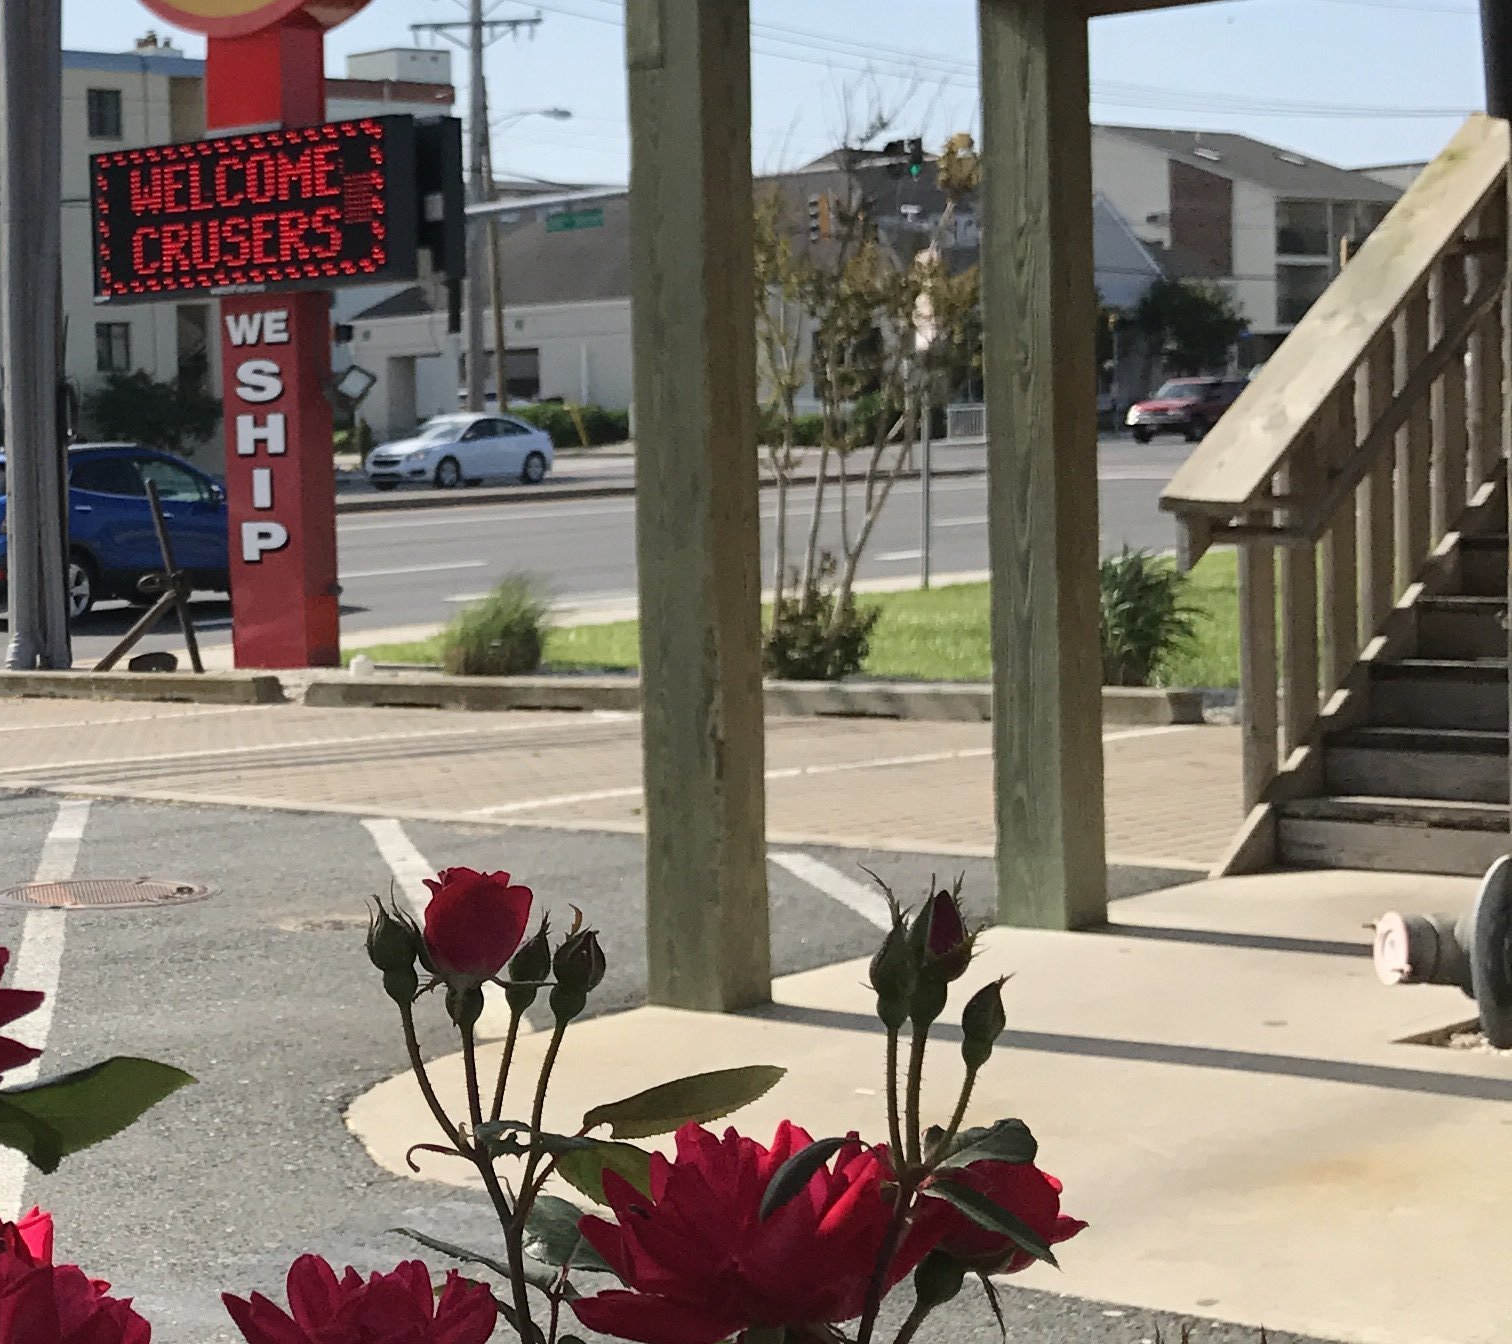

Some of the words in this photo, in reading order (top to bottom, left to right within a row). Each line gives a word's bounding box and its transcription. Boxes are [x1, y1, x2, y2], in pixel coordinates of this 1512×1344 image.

[129, 143, 341, 216] WELCOME
[131, 205, 343, 275] CRUSERS
[225, 310, 290, 347] WE
[235, 359, 290, 563] SHIP
